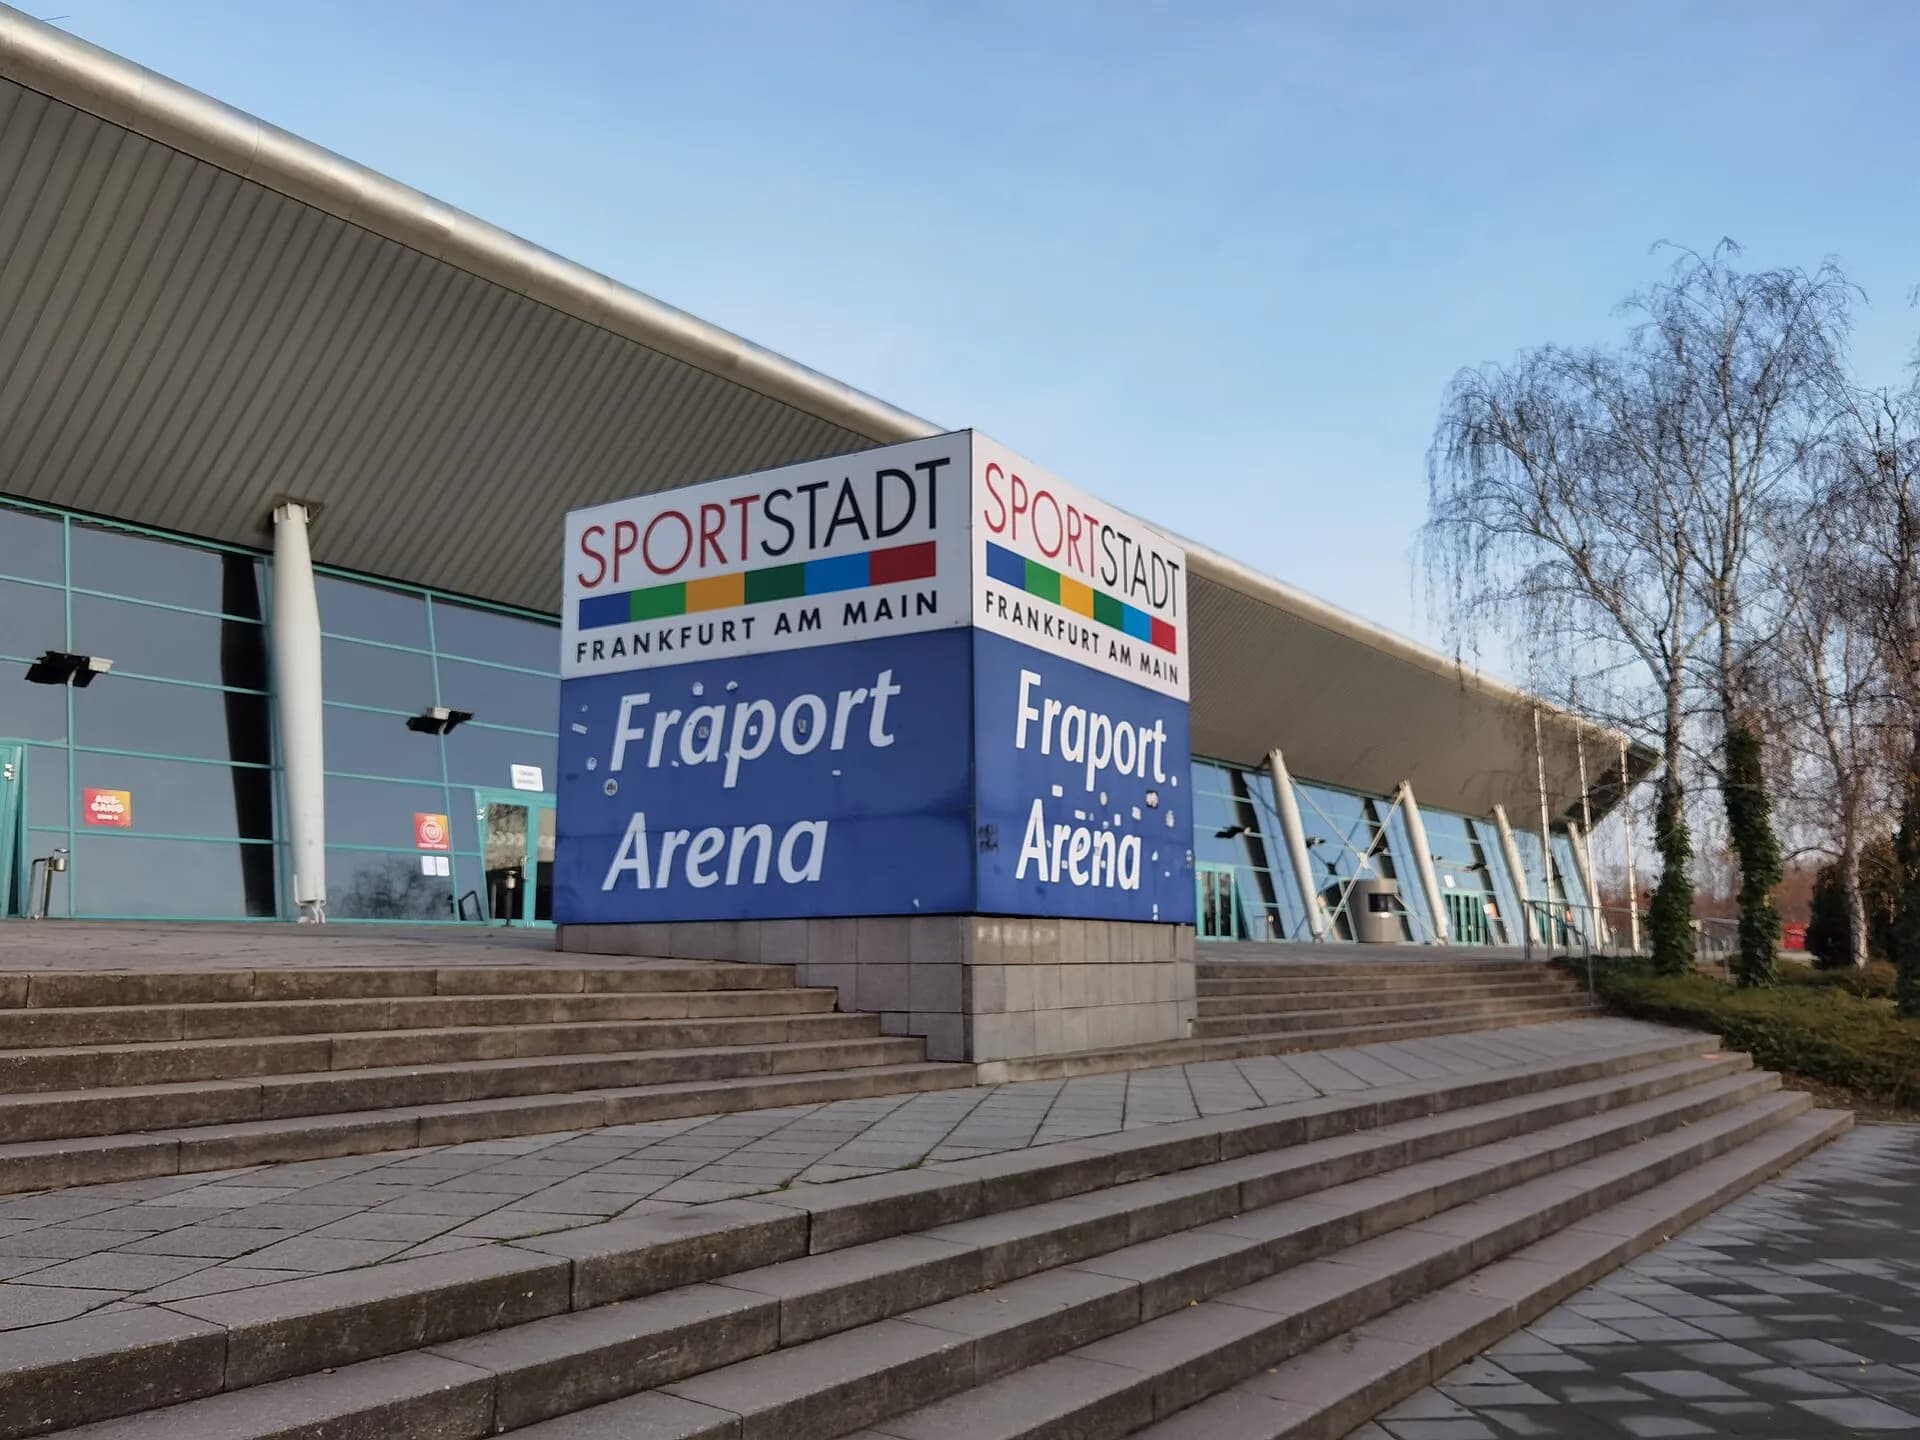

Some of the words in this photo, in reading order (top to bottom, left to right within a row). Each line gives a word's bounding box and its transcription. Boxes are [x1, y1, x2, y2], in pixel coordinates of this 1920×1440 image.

[578, 457, 950, 588] SPORTSTADT
[984, 463, 1180, 617] SPORTSTADT
[577, 617, 755, 663] FRANKFURT
[774, 607, 822, 636] AM
[843, 590, 936, 626] MAIN
[986, 590, 1100, 654] FRANKFURT
[1109, 641, 1132, 667] AM
[1140, 652, 1178, 684] MAIN
[610, 669, 901, 788] Fraport
[1016, 669, 1167, 792] Fraport
[601, 812, 828, 890] Arena
[1016, 798, 1142, 890] Arena
